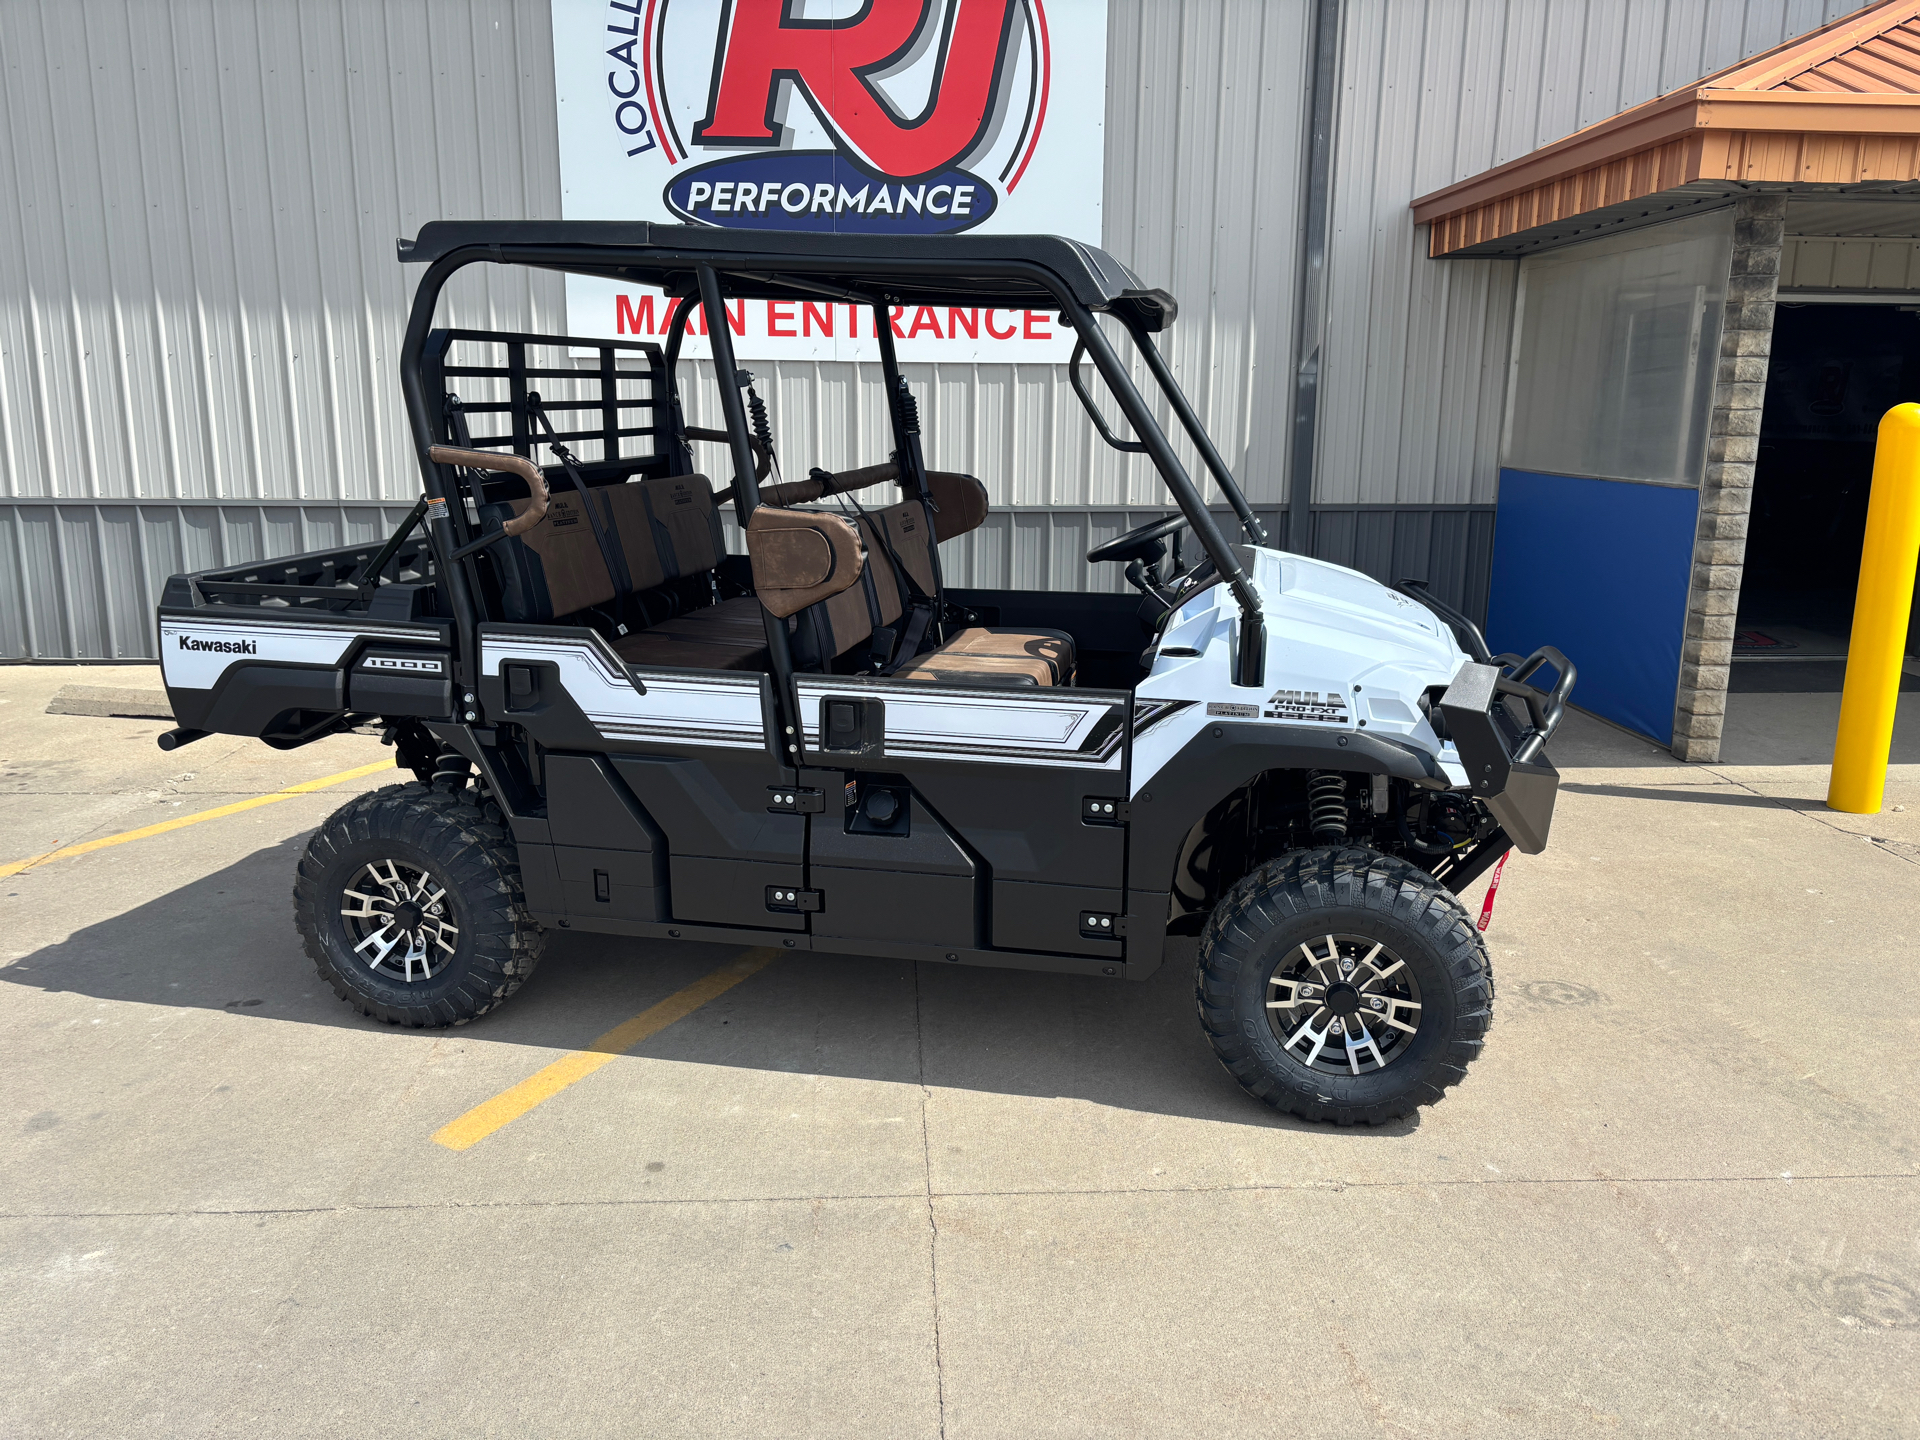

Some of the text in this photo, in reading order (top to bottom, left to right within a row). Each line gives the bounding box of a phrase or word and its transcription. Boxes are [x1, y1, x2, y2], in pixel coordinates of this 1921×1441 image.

[687, 182, 975, 215] PERFORMANCE
[767, 300, 1052, 340] ENTRANCE
[179, 635, 257, 654] Kawasaki
[370, 660, 438, 669] 1000
[1267, 690, 1347, 708] MULE
[1274, 705, 1339, 714] PRO-FXT
